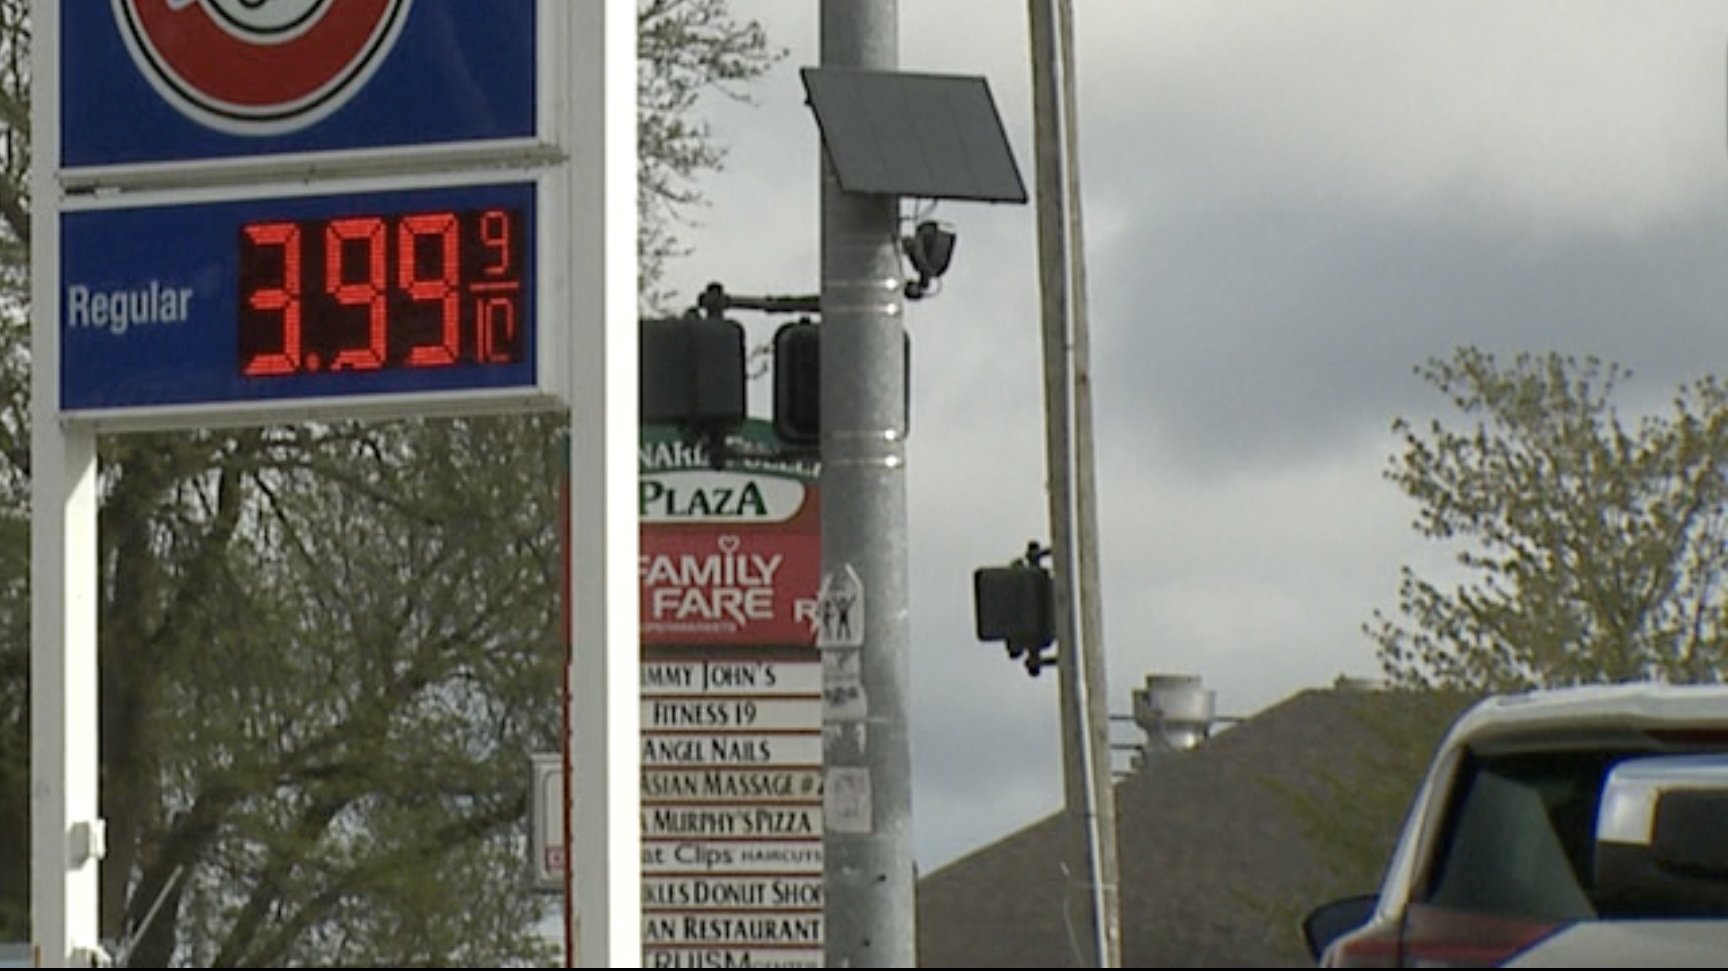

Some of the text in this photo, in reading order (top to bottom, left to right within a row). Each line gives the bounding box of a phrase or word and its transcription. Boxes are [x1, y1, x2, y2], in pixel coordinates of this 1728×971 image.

[68, 279, 193, 335] Regular
[245, 212, 460, 376] 3.99
[640, 480, 768, 516] PLAZA
[652, 587, 775, 626] FARE
[702, 660, 776, 691] JOHN'S
[653, 701, 757, 725] FITNESS 19
[642, 737, 771, 762] ANGEL NAILS
[704, 770, 792, 796] MASSAGE
[654, 809, 753, 833] MURPHY'S
[756, 809, 812, 834] PIZZA
[674, 843, 733, 870] Clips
[694, 880, 765, 905] DONUT
[684, 916, 820, 941] RESTAURANT
